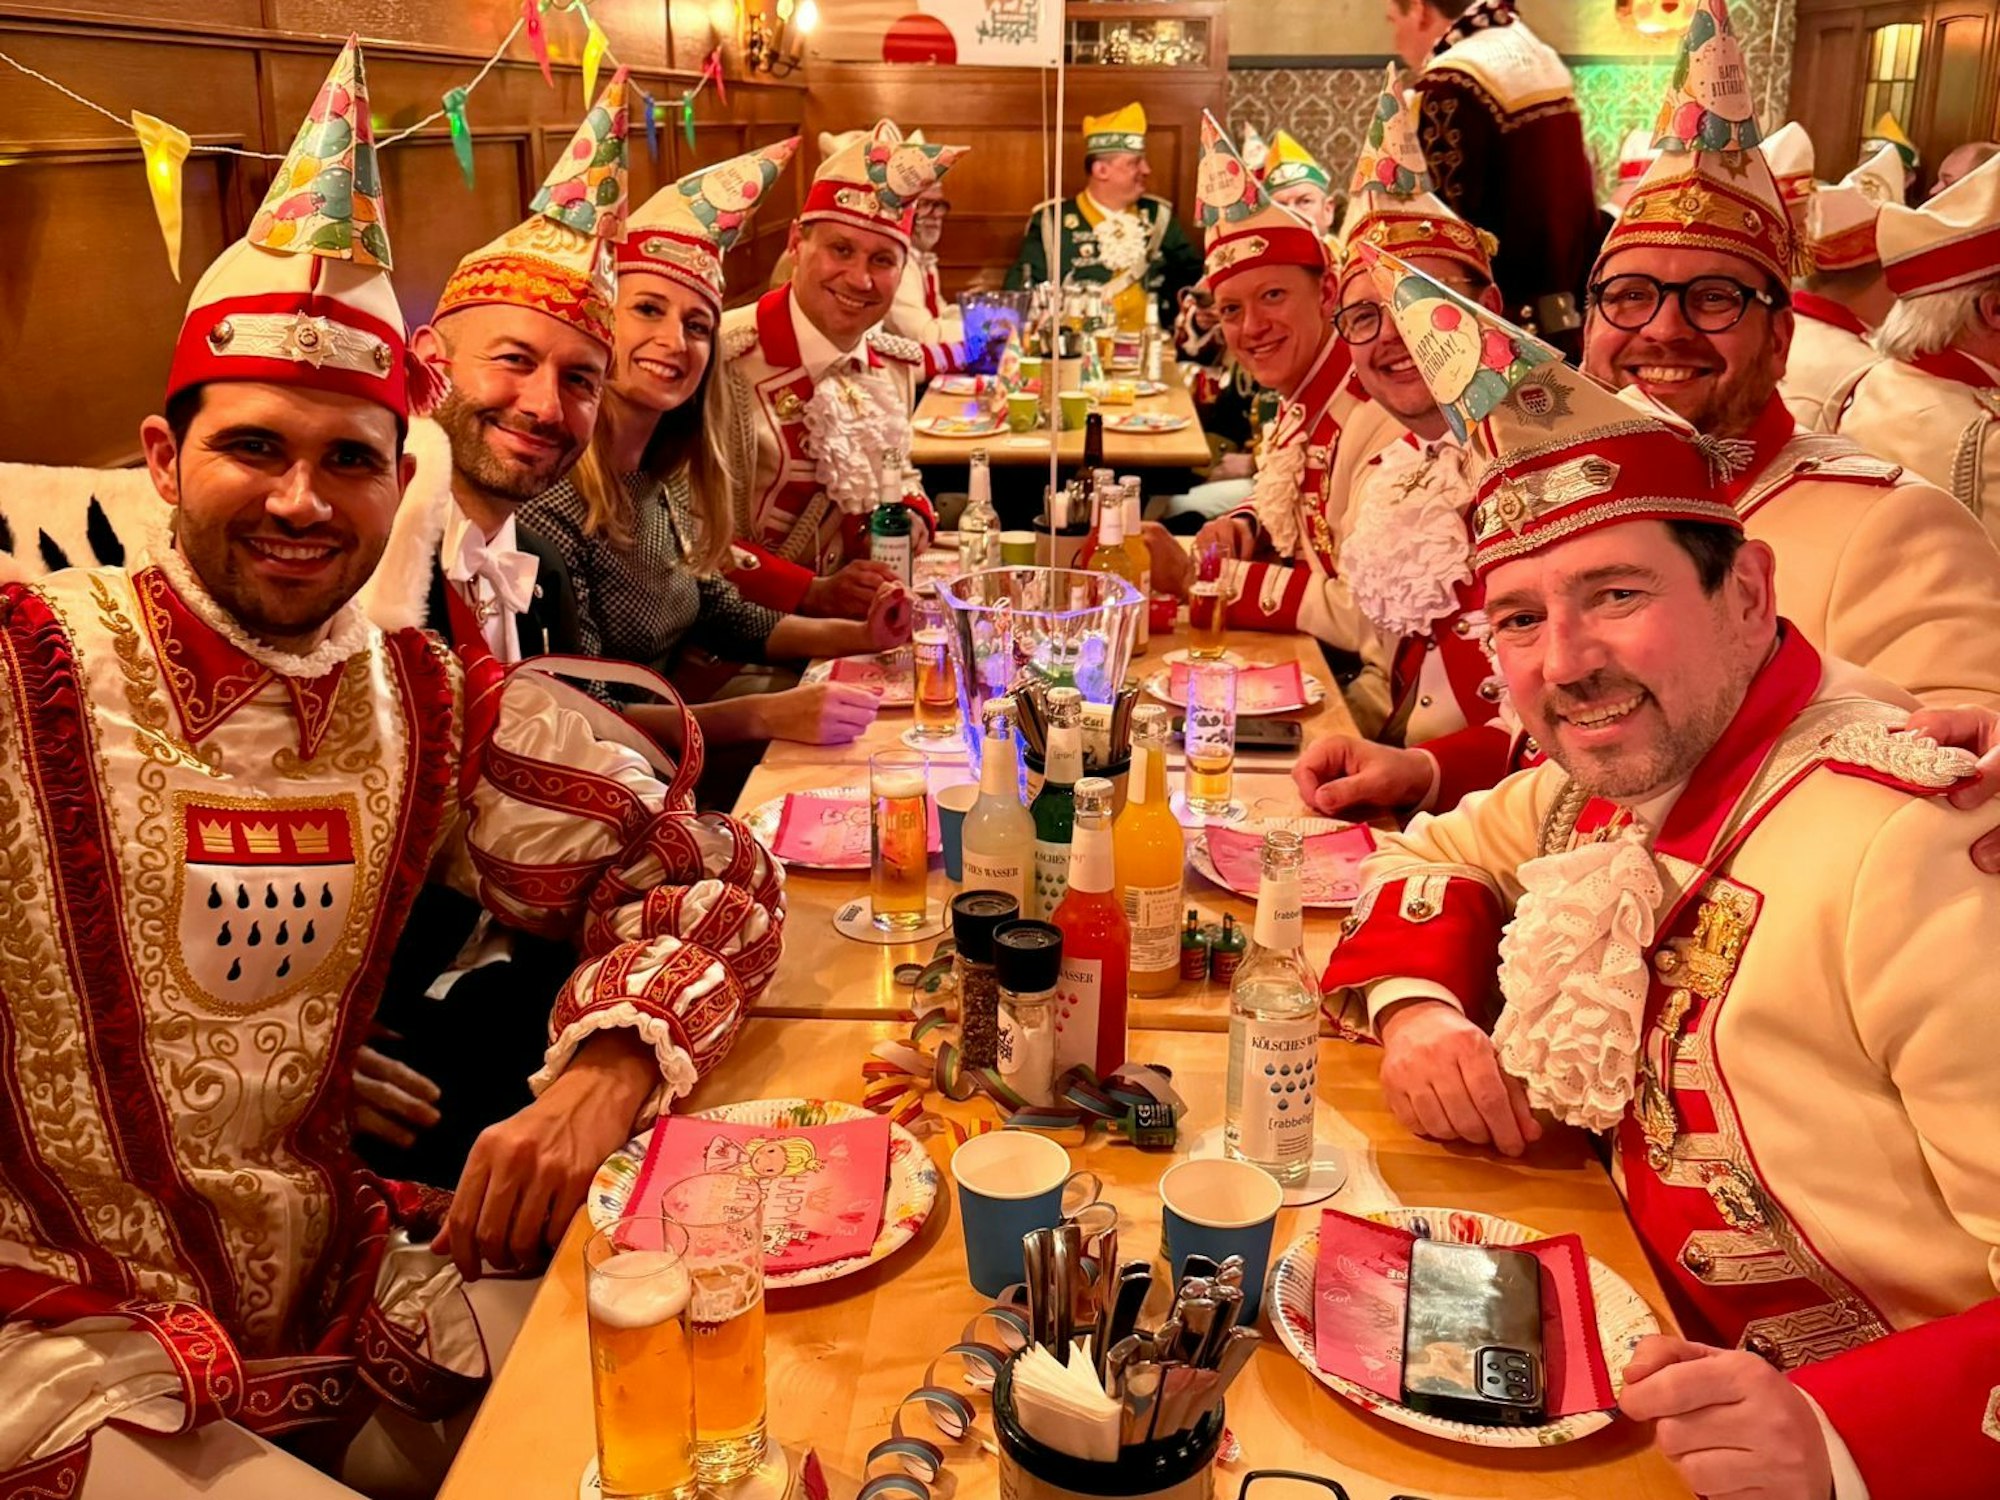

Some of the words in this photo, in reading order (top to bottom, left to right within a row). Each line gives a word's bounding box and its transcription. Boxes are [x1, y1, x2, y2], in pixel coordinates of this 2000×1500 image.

[984, 866, 1019, 878] WASSER
[1251, 1036, 1307, 1051] KÖLSCHES
[1268, 1113, 1313, 1130] [rabbelig
